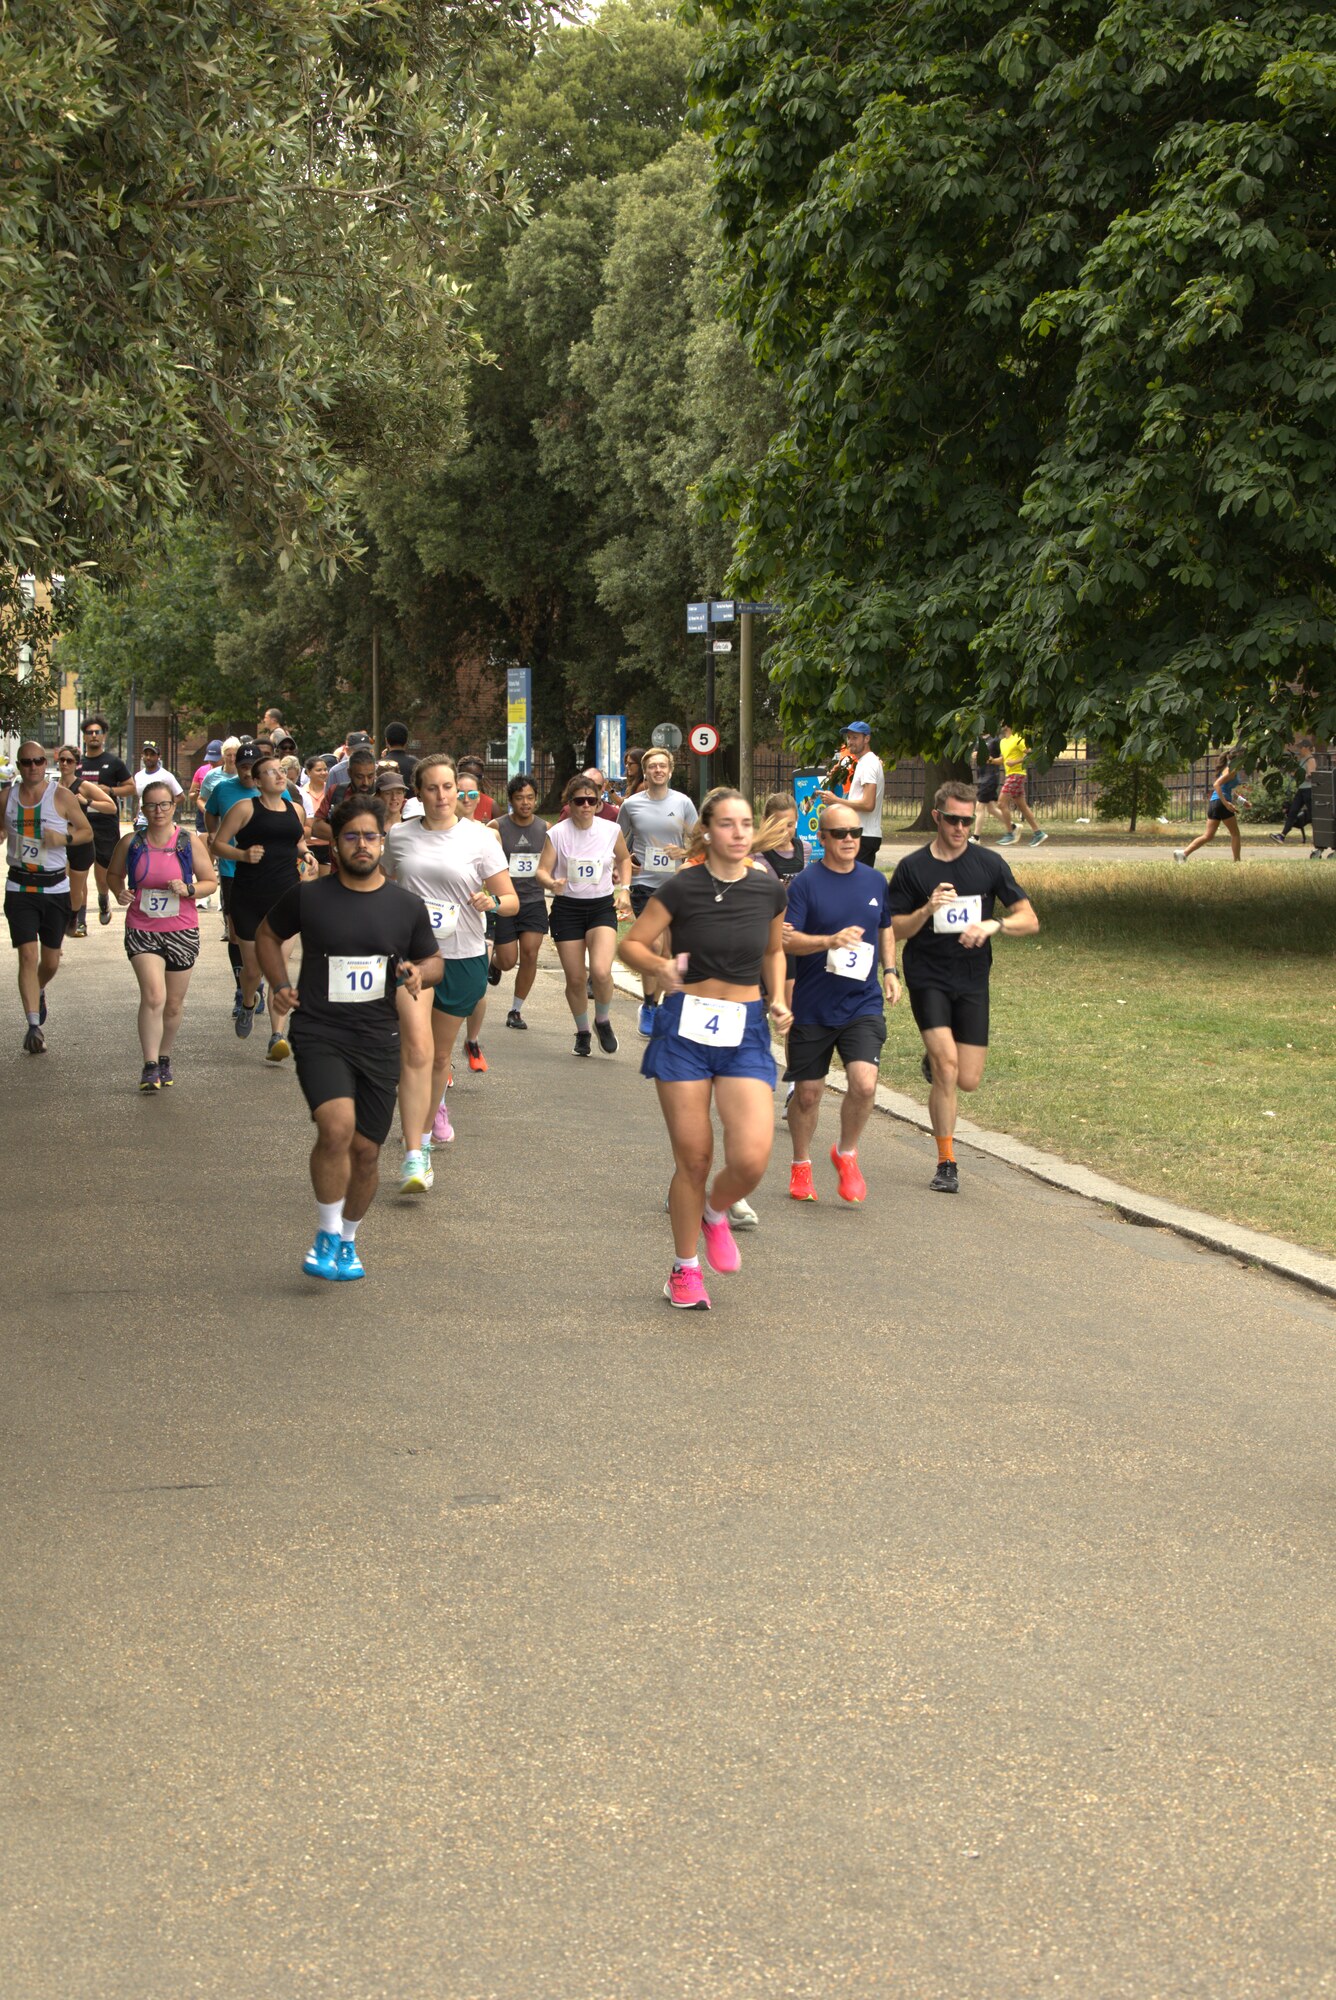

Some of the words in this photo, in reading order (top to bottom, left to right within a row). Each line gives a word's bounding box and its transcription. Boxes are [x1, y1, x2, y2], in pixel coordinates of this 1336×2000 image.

[699, 733, 709, 746] 5
[22, 844, 39, 858] 79
[517, 860, 533, 872] 33
[652, 854, 669, 867] 50
[577, 865, 594, 878] 19
[149, 897, 169, 911] 37
[946, 907, 970, 924] 64
[845, 951, 858, 968] 3
[346, 970, 373, 991] 10
[704, 1014, 720, 1035] 4
